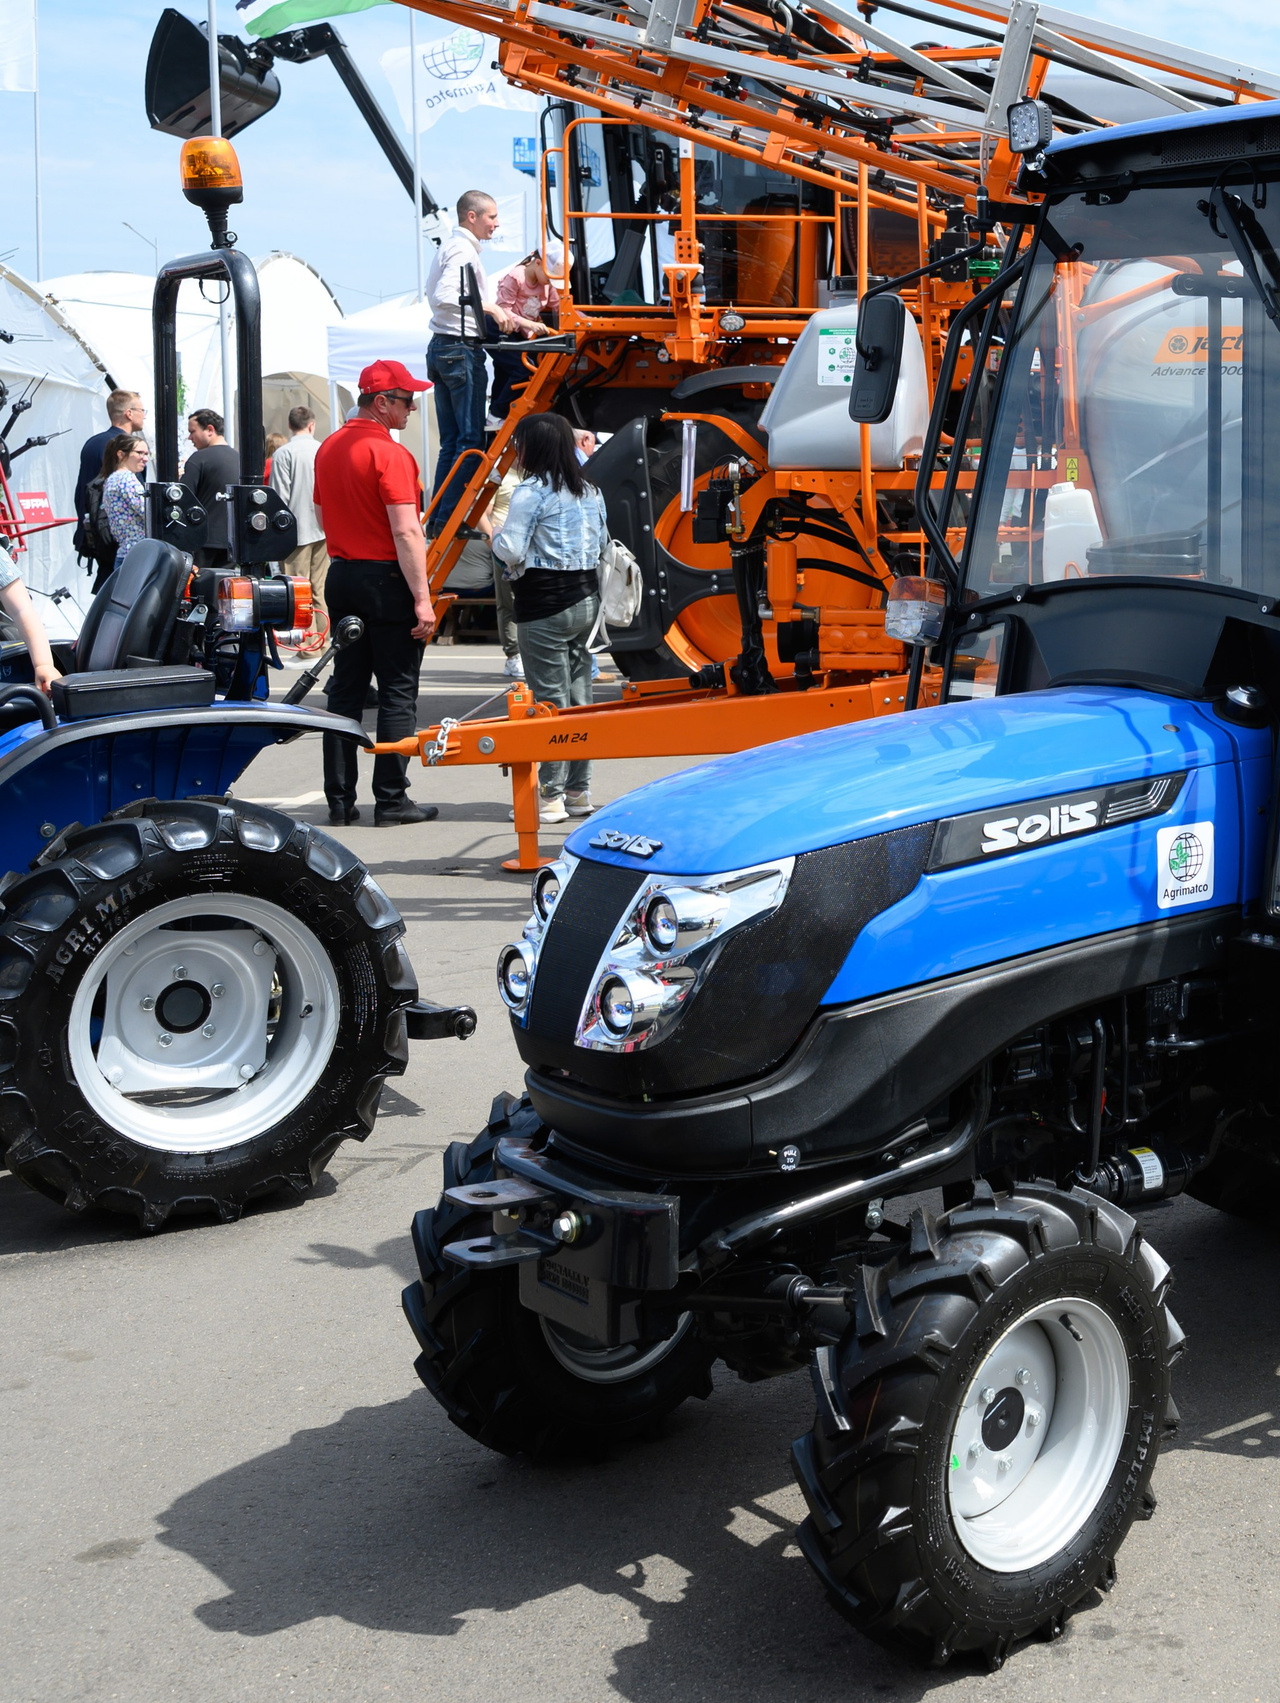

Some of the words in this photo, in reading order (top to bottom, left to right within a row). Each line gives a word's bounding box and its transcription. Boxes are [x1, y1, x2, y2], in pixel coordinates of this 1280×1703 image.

[1151, 366, 1206, 377] Advance
[549, 734, 569, 744] AM
[571, 732, 588, 743] 24
[1162, 883, 1209, 901] Agrimatco
